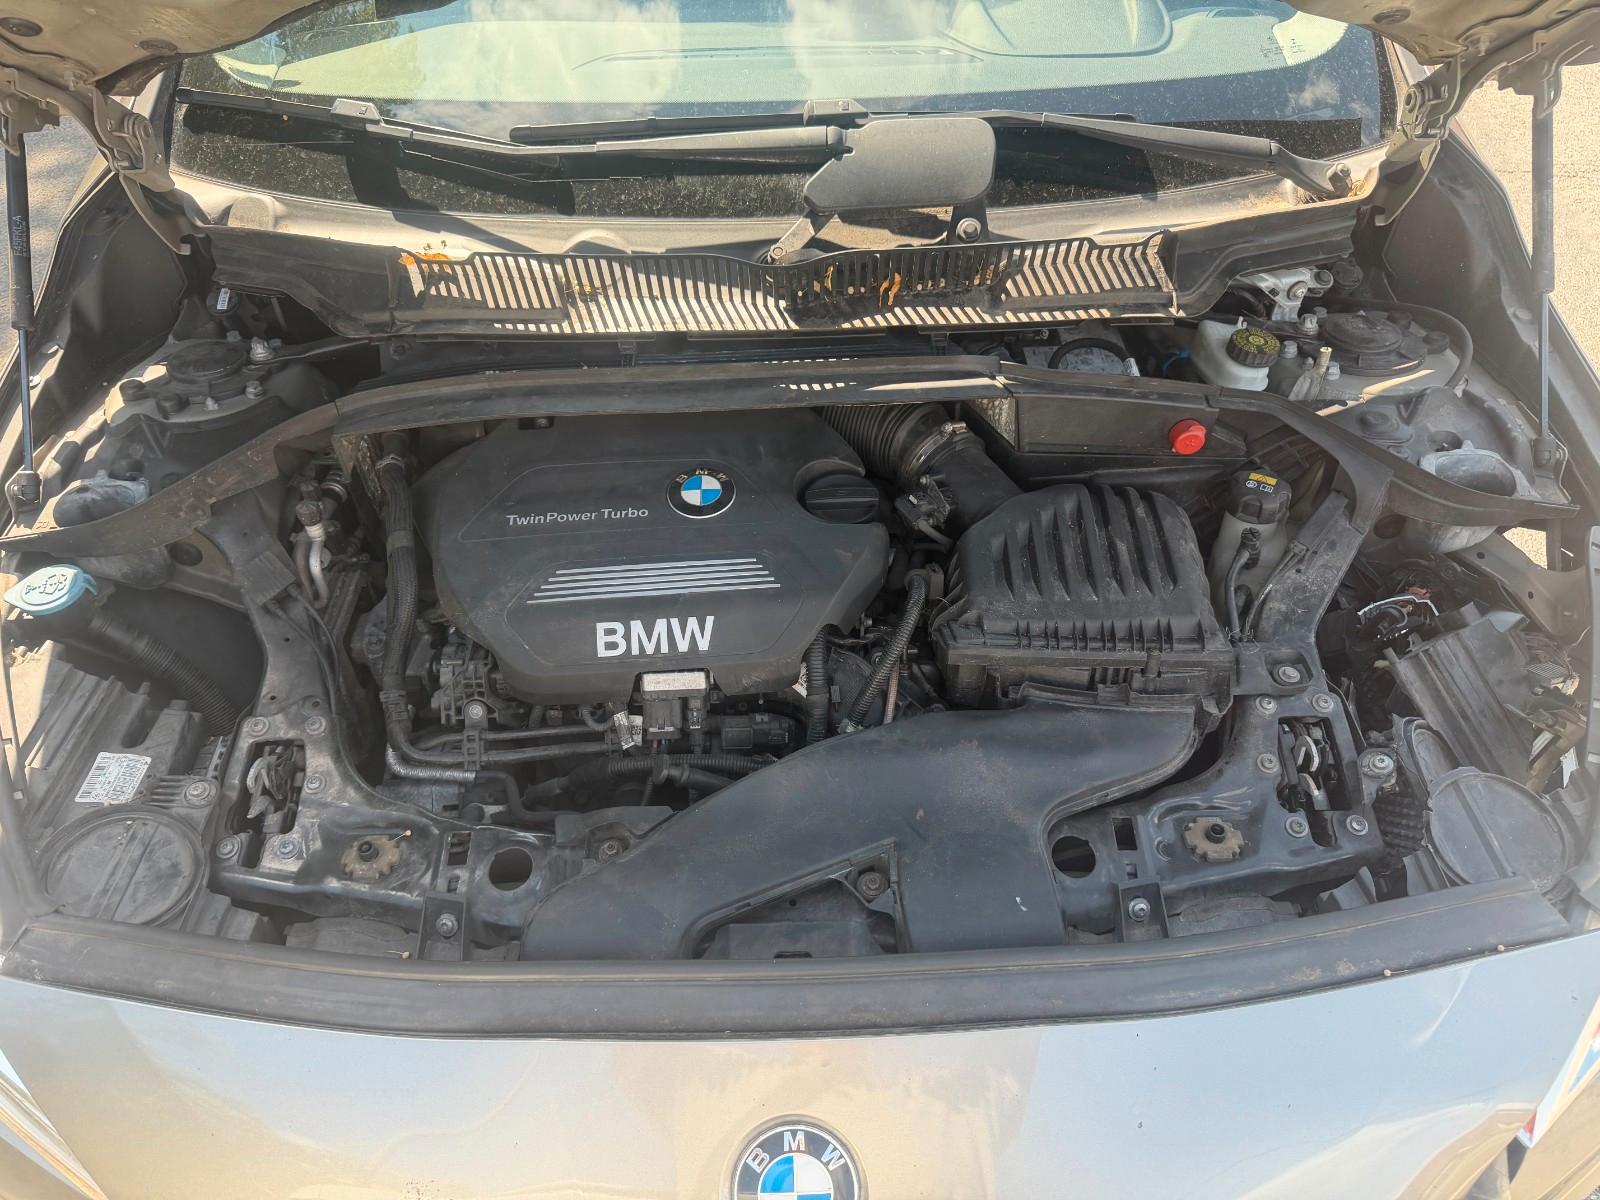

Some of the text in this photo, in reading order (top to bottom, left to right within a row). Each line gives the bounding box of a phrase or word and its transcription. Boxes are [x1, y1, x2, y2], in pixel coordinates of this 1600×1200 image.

[675, 468, 729, 484] BMW
[600, 507, 649, 519] Turbo
[595, 615, 715, 657] BMW
[745, 1130, 846, 1174] BMW
